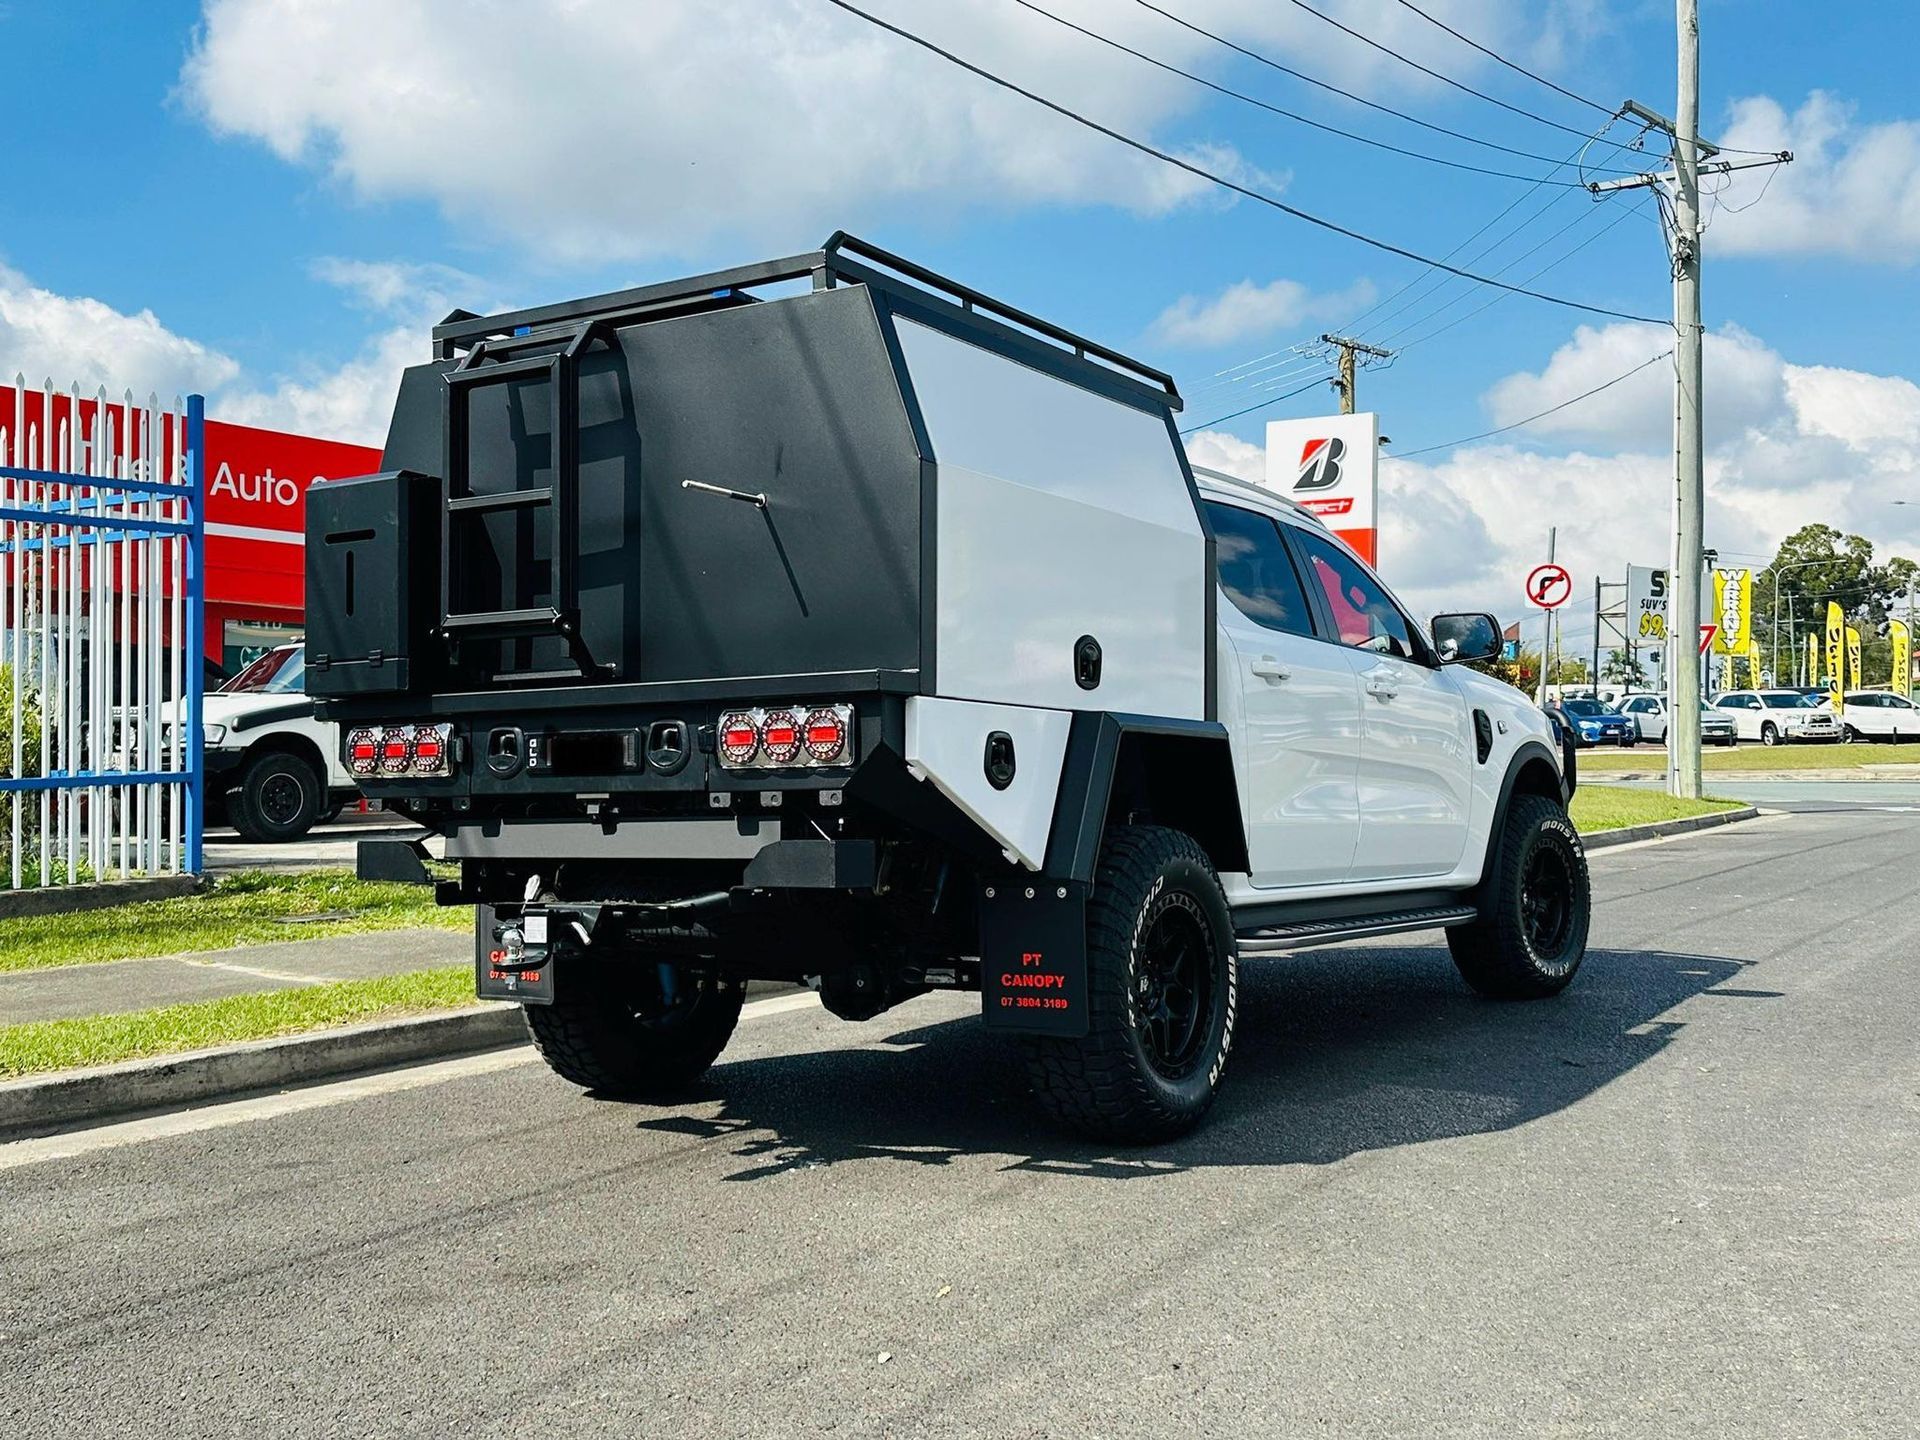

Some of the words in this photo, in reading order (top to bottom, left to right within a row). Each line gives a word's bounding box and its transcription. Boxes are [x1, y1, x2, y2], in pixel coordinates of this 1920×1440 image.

[209, 462, 298, 506] Auto
[1650, 570, 1669, 597] S
[1640, 598, 1667, 610] SUV'S
[1718, 569, 1747, 649] WARRANTY
[529, 738, 537, 767] QLD
[1023, 953, 1042, 966] PT
[1001, 974, 1065, 988] CANOPY
[1001, 997, 1014, 1007] 07
[1016, 997, 1041, 1007] 3804
[1043, 998, 1068, 1009] 3189
